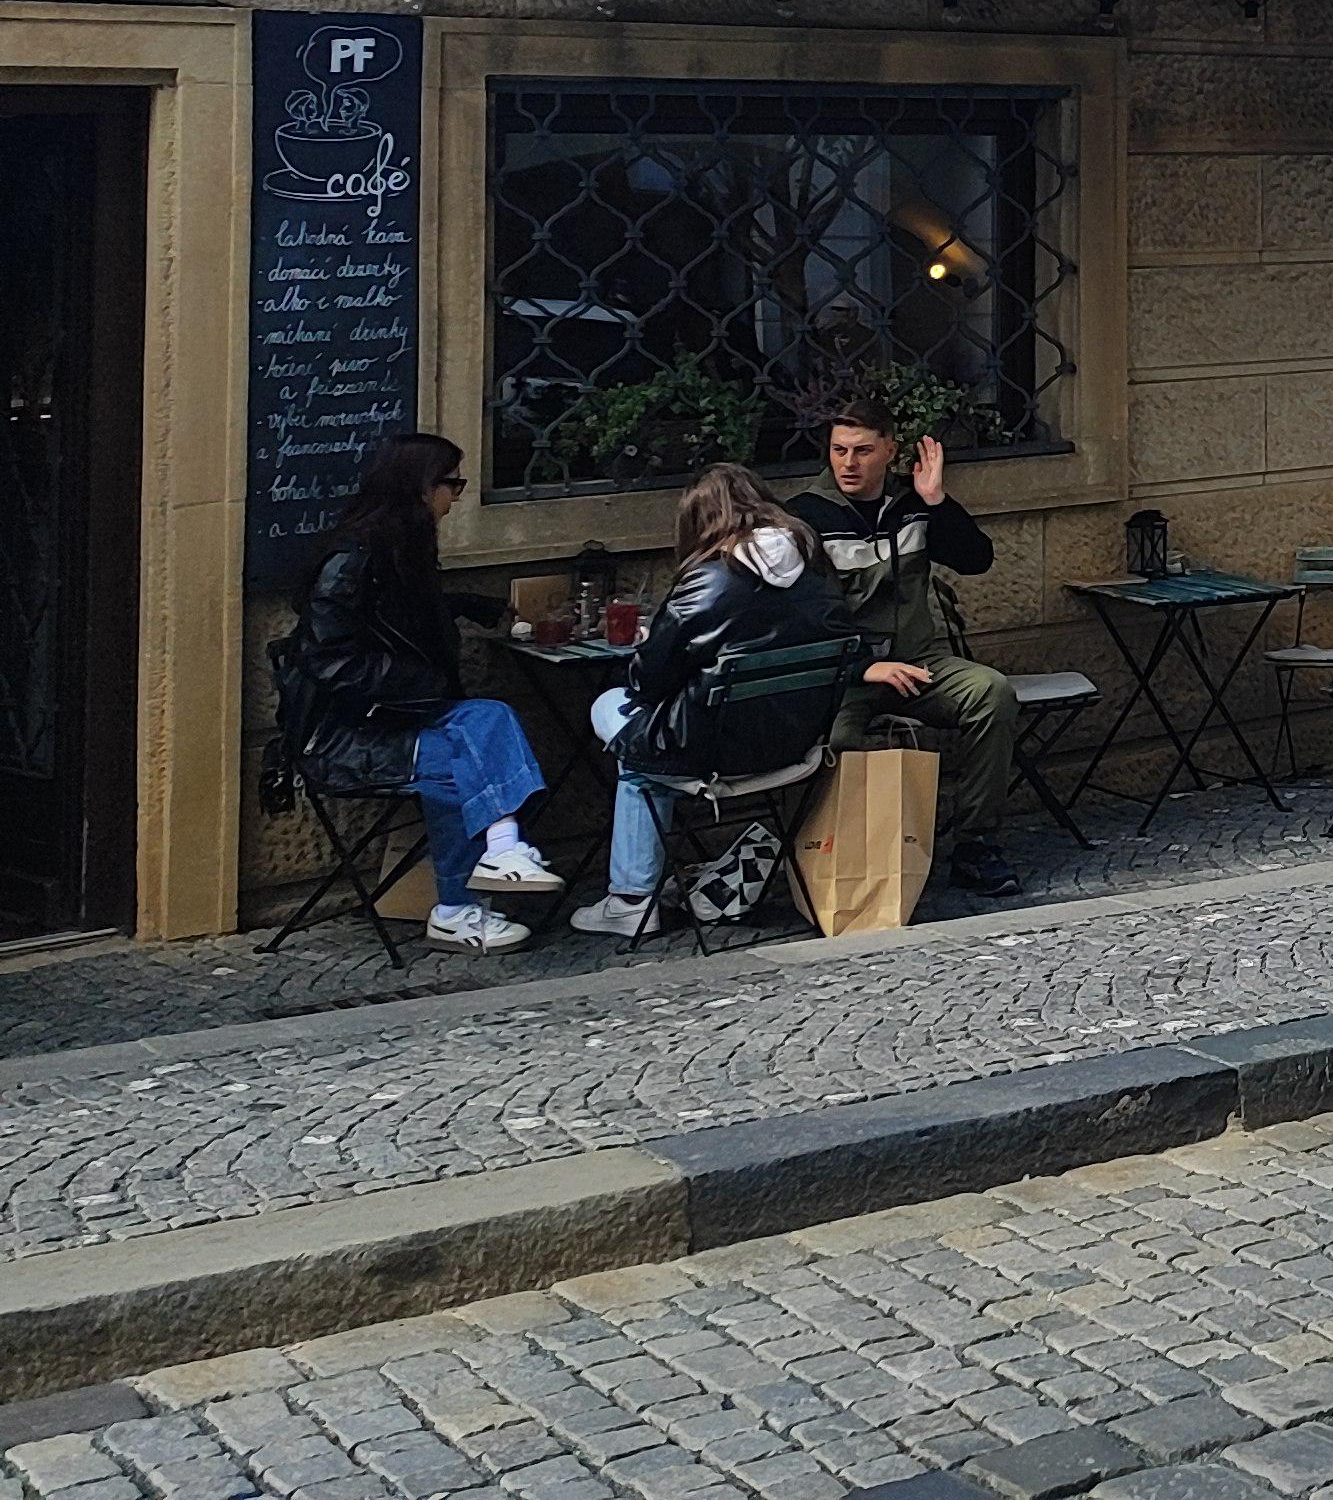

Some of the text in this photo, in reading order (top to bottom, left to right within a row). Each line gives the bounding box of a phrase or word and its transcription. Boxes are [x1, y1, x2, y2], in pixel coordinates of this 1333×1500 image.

[329, 37, 376, 73] PF
[326, 132, 411, 217] café
[274, 218, 413, 247] lahodná káva
[268, 256, 331, 282] domácí
[349, 316, 412, 363] drinky
[329, 357, 381, 377] pivo
[279, 385, 298, 400] a
[268, 522, 288, 538] a
